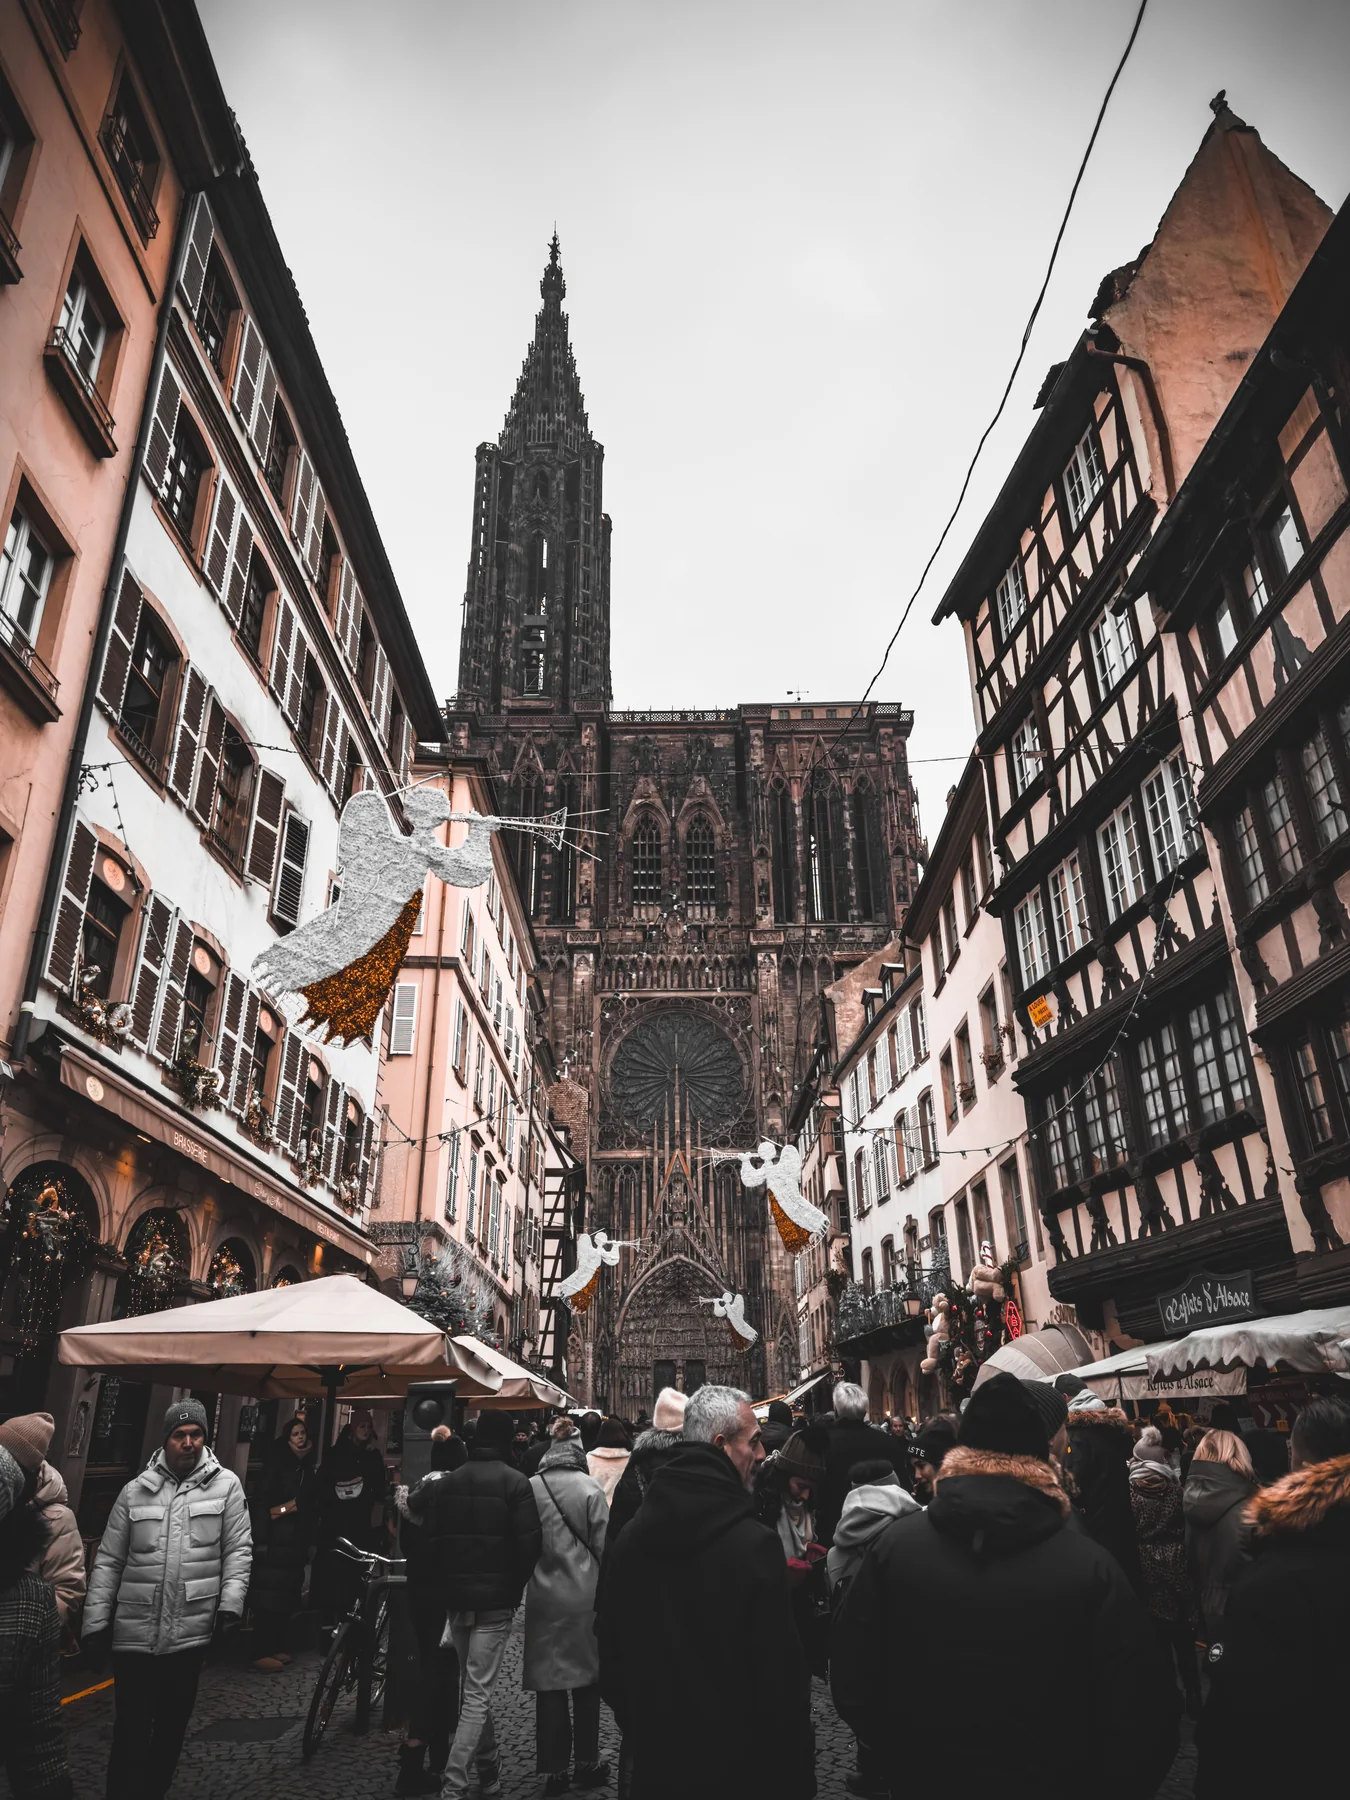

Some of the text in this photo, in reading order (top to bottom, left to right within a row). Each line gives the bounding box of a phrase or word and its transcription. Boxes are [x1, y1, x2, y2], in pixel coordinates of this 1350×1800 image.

[173, 1131, 208, 1164] BRASSERIE
[1009, 1306, 1020, 1340] TABAC
[1165, 1292, 1203, 1324] Reflets
